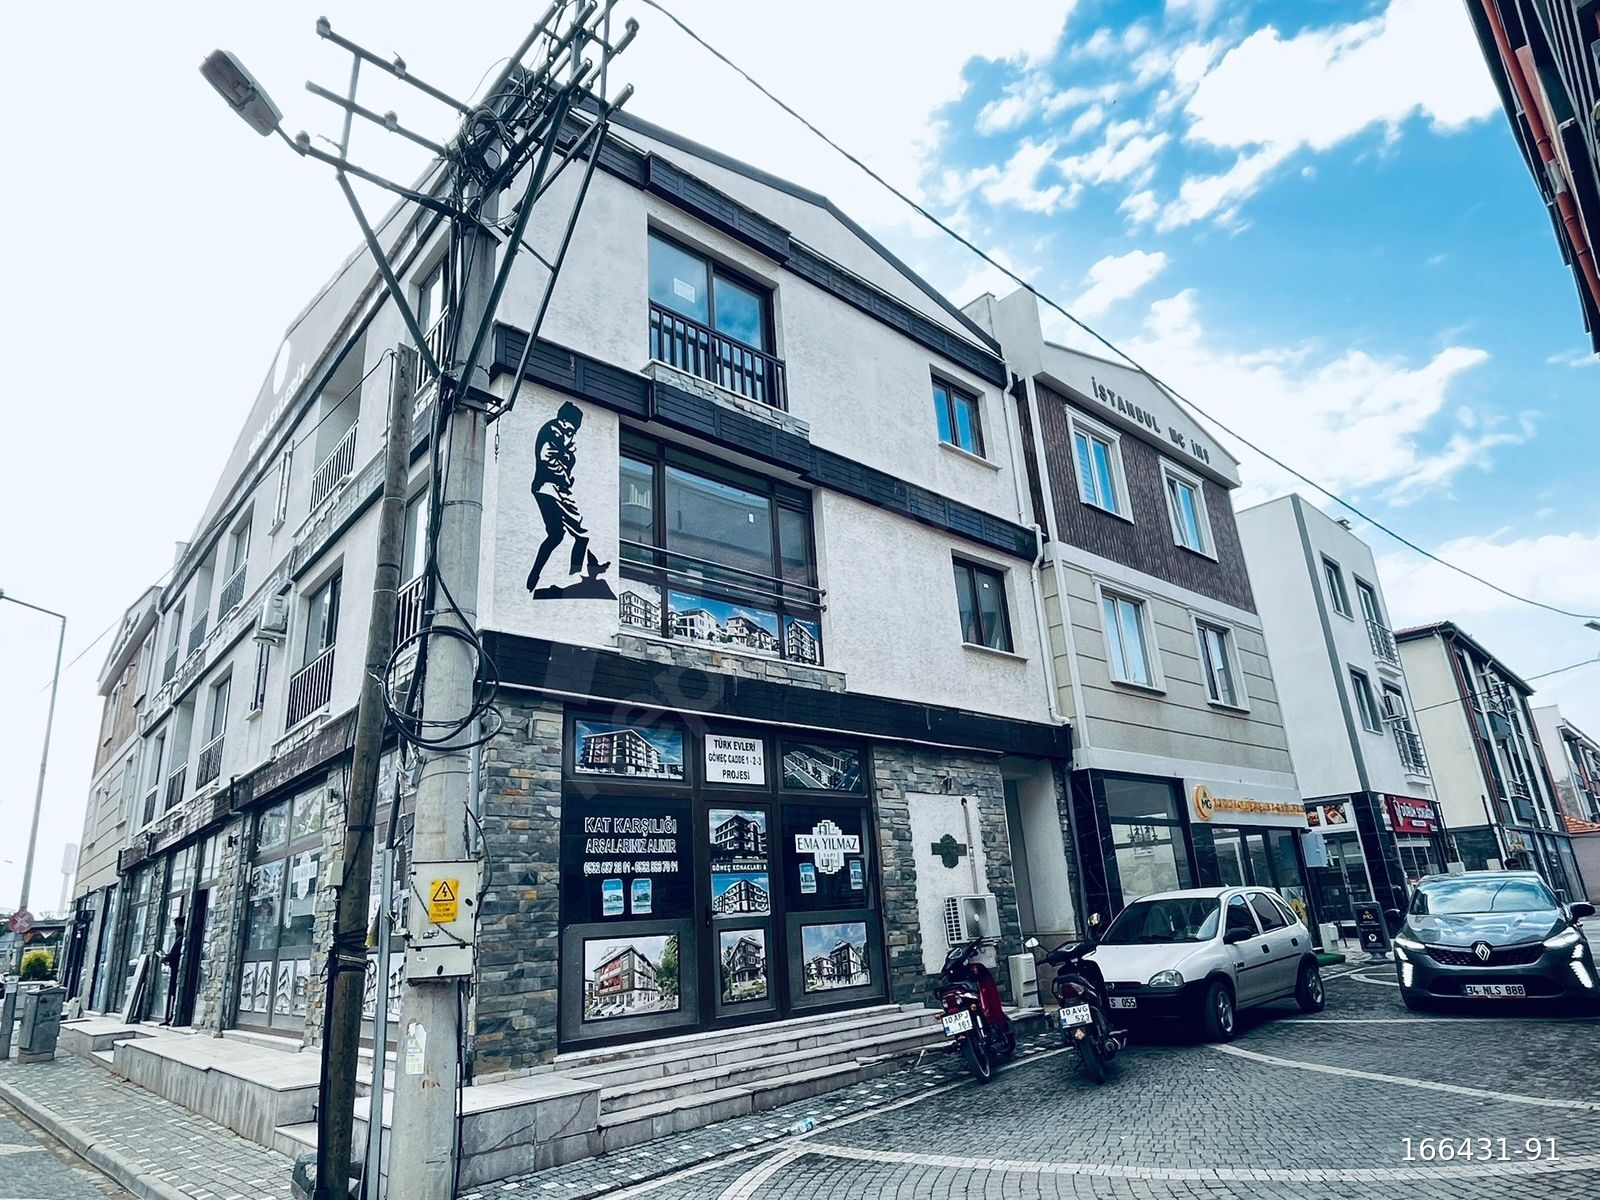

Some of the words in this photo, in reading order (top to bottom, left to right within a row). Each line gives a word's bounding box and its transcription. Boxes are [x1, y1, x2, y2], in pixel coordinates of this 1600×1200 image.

[714, 737, 732, 750] TÜRK
[734, 741, 756, 752] EVLERİ
[708, 752, 727, 765] GÖMEÇ
[728, 754, 745, 764] CADDE
[722, 769, 750, 780] PROJESİ
[1201, 798, 1212, 809] MG
[584, 817, 612, 833] KAT
[613, 815, 677, 837] KARŞILIĞI
[647, 839, 677, 853] ALINIR
[797, 837, 820, 850] EMA
[822, 837, 858, 851] YILMAZ
[1466, 985, 1479, 995] 34
[1483, 985, 1501, 995] NLS
[1505, 984, 1524, 995] 888
[1121, 997, 1137, 1008] 055
[1062, 1009, 1071, 1017] 10
[1072, 1006, 1088, 1015] AVG
